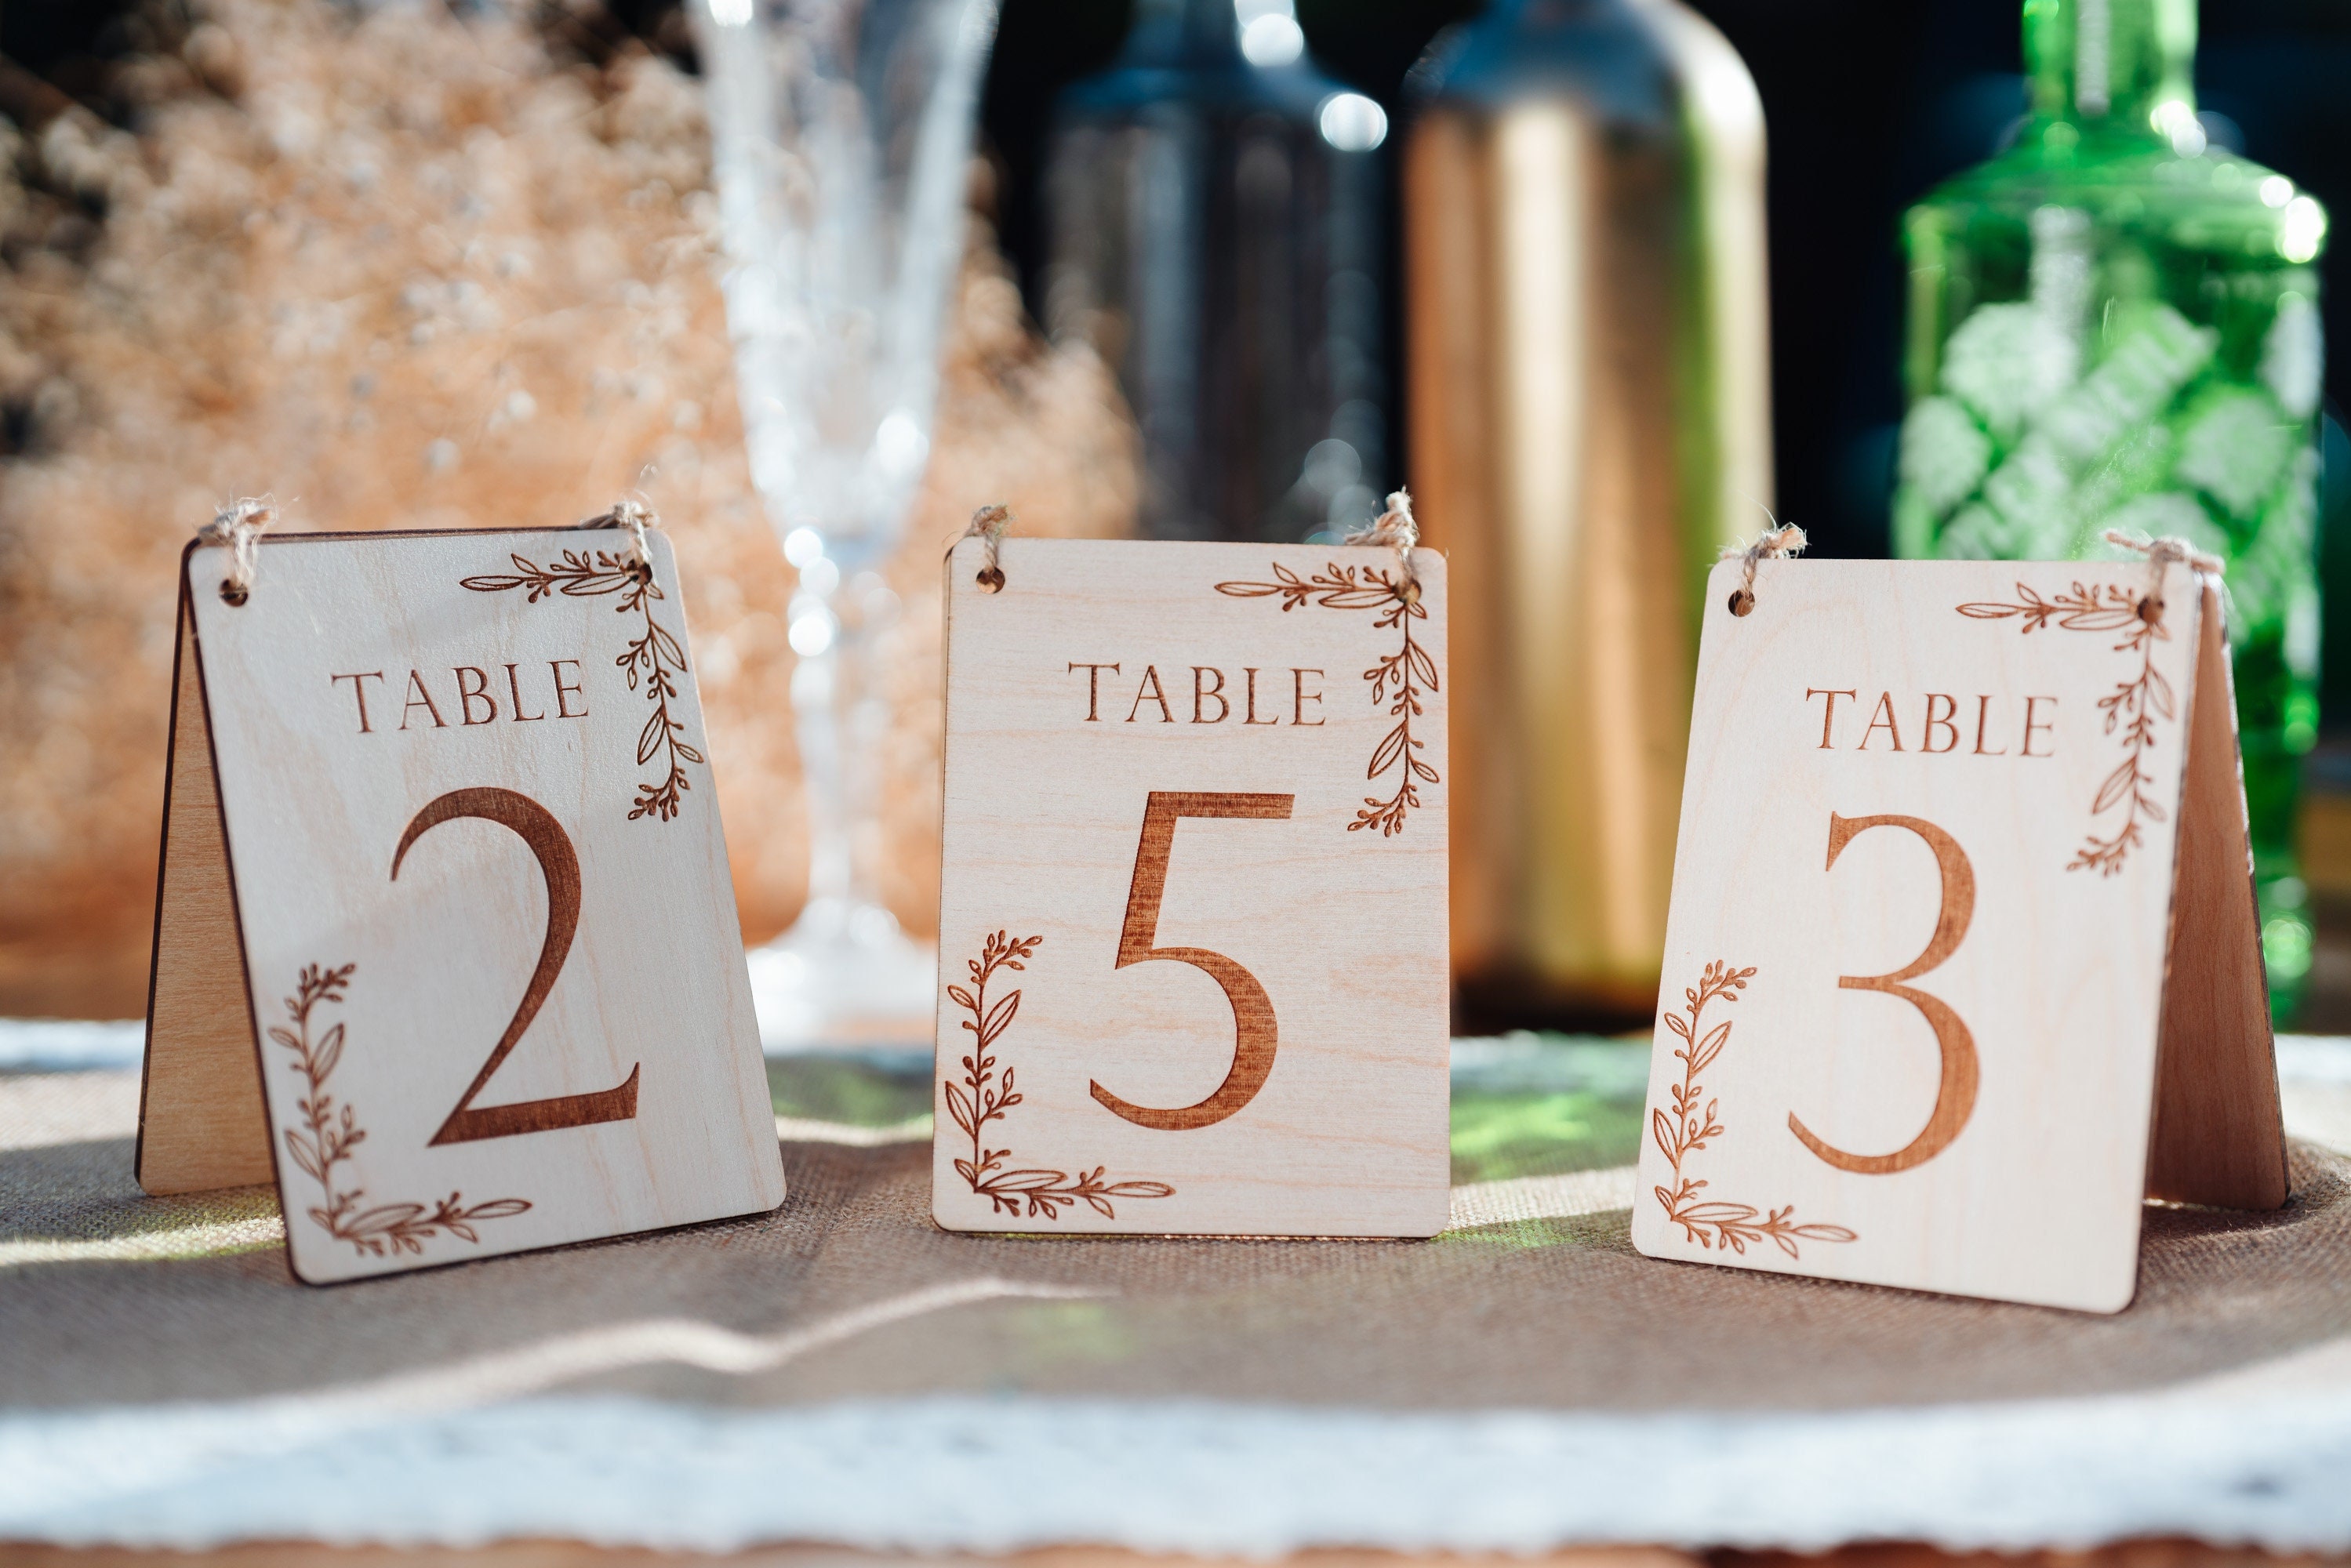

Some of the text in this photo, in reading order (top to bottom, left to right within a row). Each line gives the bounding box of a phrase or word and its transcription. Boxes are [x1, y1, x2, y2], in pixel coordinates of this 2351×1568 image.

[331, 659, 590, 734] TABLE
[1067, 661, 1327, 726] TABLE
[1805, 687, 2058, 757] TABLE
[389, 786, 640, 1148] 2
[1089, 790, 1295, 1131] 5
[1787, 811, 1981, 1176] 3
